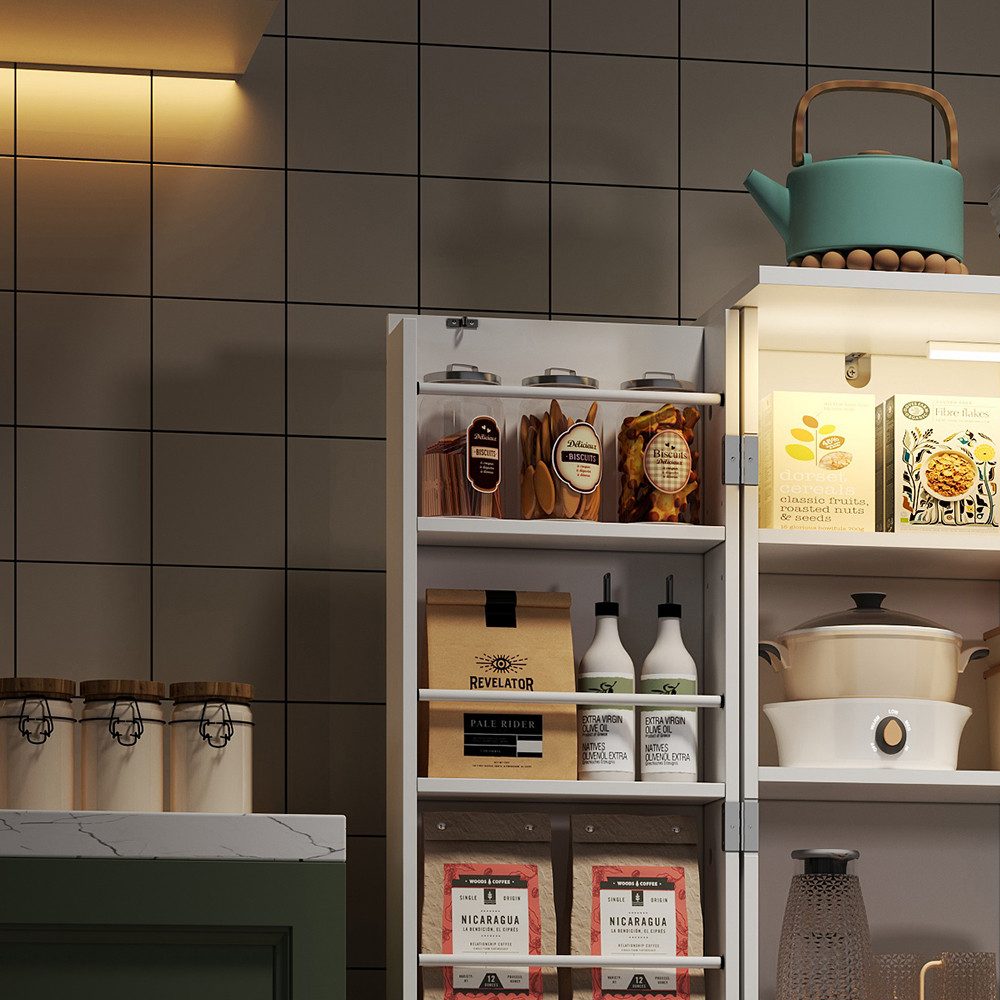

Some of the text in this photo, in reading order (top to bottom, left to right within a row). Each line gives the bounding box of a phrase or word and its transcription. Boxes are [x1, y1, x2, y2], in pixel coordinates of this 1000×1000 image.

[935, 407, 990, 418] Fibre flakes
[569, 453, 597, 462] BISCUITS
[653, 449, 688, 459] Biscuits
[780, 496, 870, 507] classic fruits,
[795, 514, 832, 522] seeds
[469, 676, 534, 692] REVELATOR
[470, 719, 536, 729] PALE RIDER
[582, 715, 623, 724] EXTRA VIRGIN
[645, 716, 686, 725] EXTRA VIRGIN
[582, 723, 610, 733] OLIVE OIL
[645, 725, 673, 734] OLIVE OIL
[582, 742, 606, 751] NATIVES
[645, 743, 669, 752] NATIVES
[609, 751, 628, 761] EXTRA
[672, 752, 691, 762] EXTRA
[461, 915, 520, 925] NICARAGUA
[609, 916, 667, 927] NICARAGUA
[487, 975, 496, 983] 12
[635, 976, 643, 984] 12
